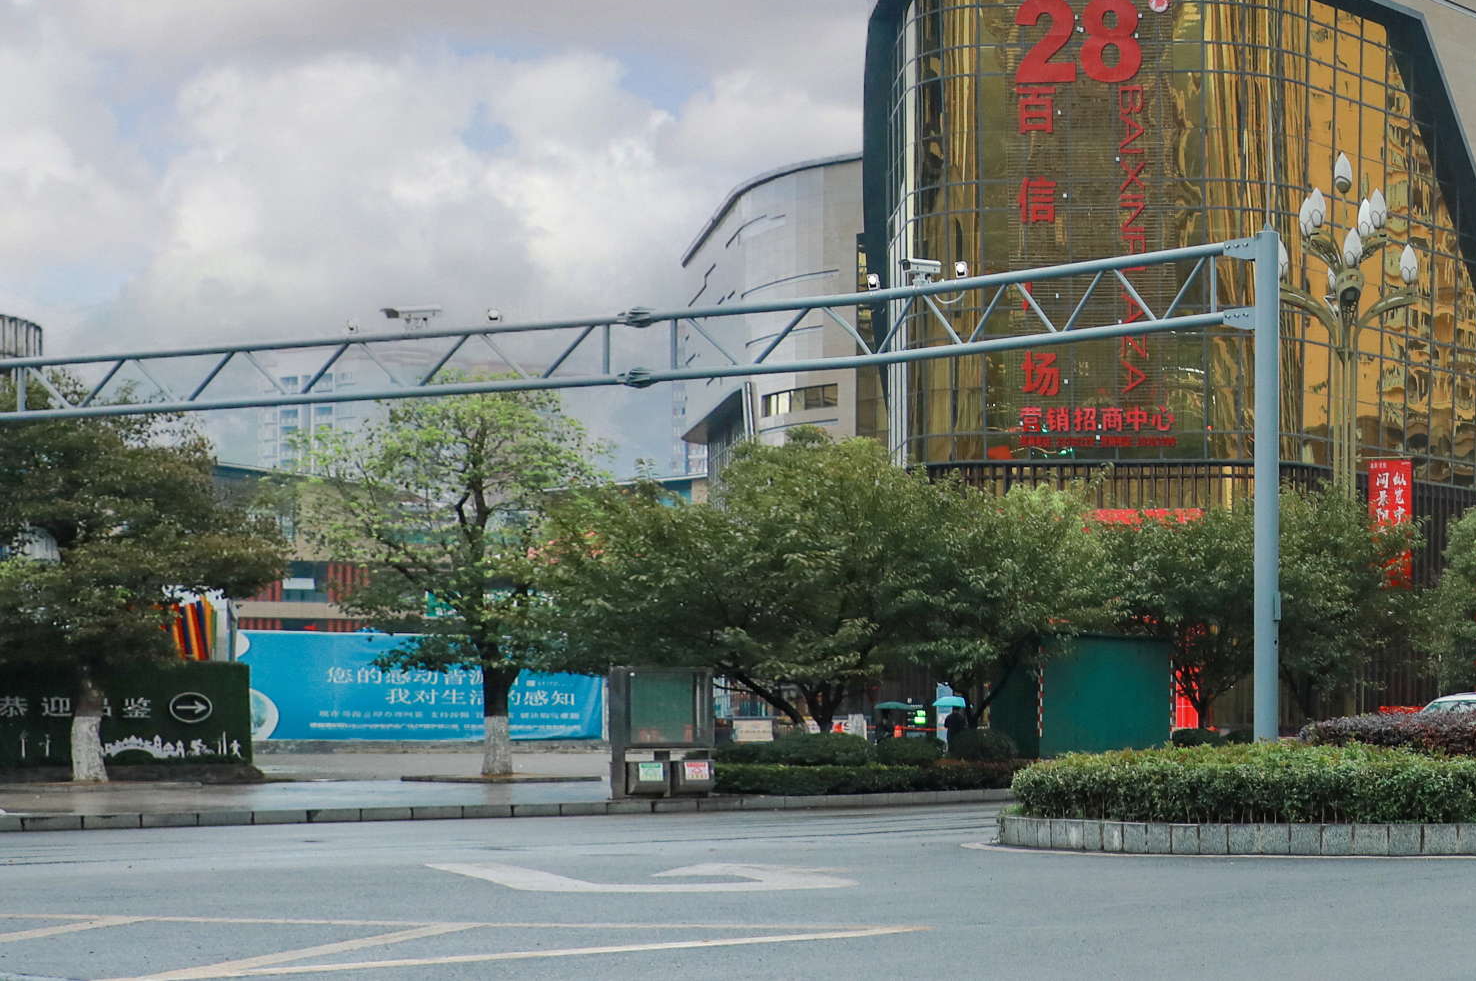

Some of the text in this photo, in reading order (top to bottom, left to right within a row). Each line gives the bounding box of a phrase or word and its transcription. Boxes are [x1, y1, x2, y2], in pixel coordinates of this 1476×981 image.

[1019, 405, 1175, 433] 营销招商中心
[326, 666, 519, 686] 您的感动皆源
